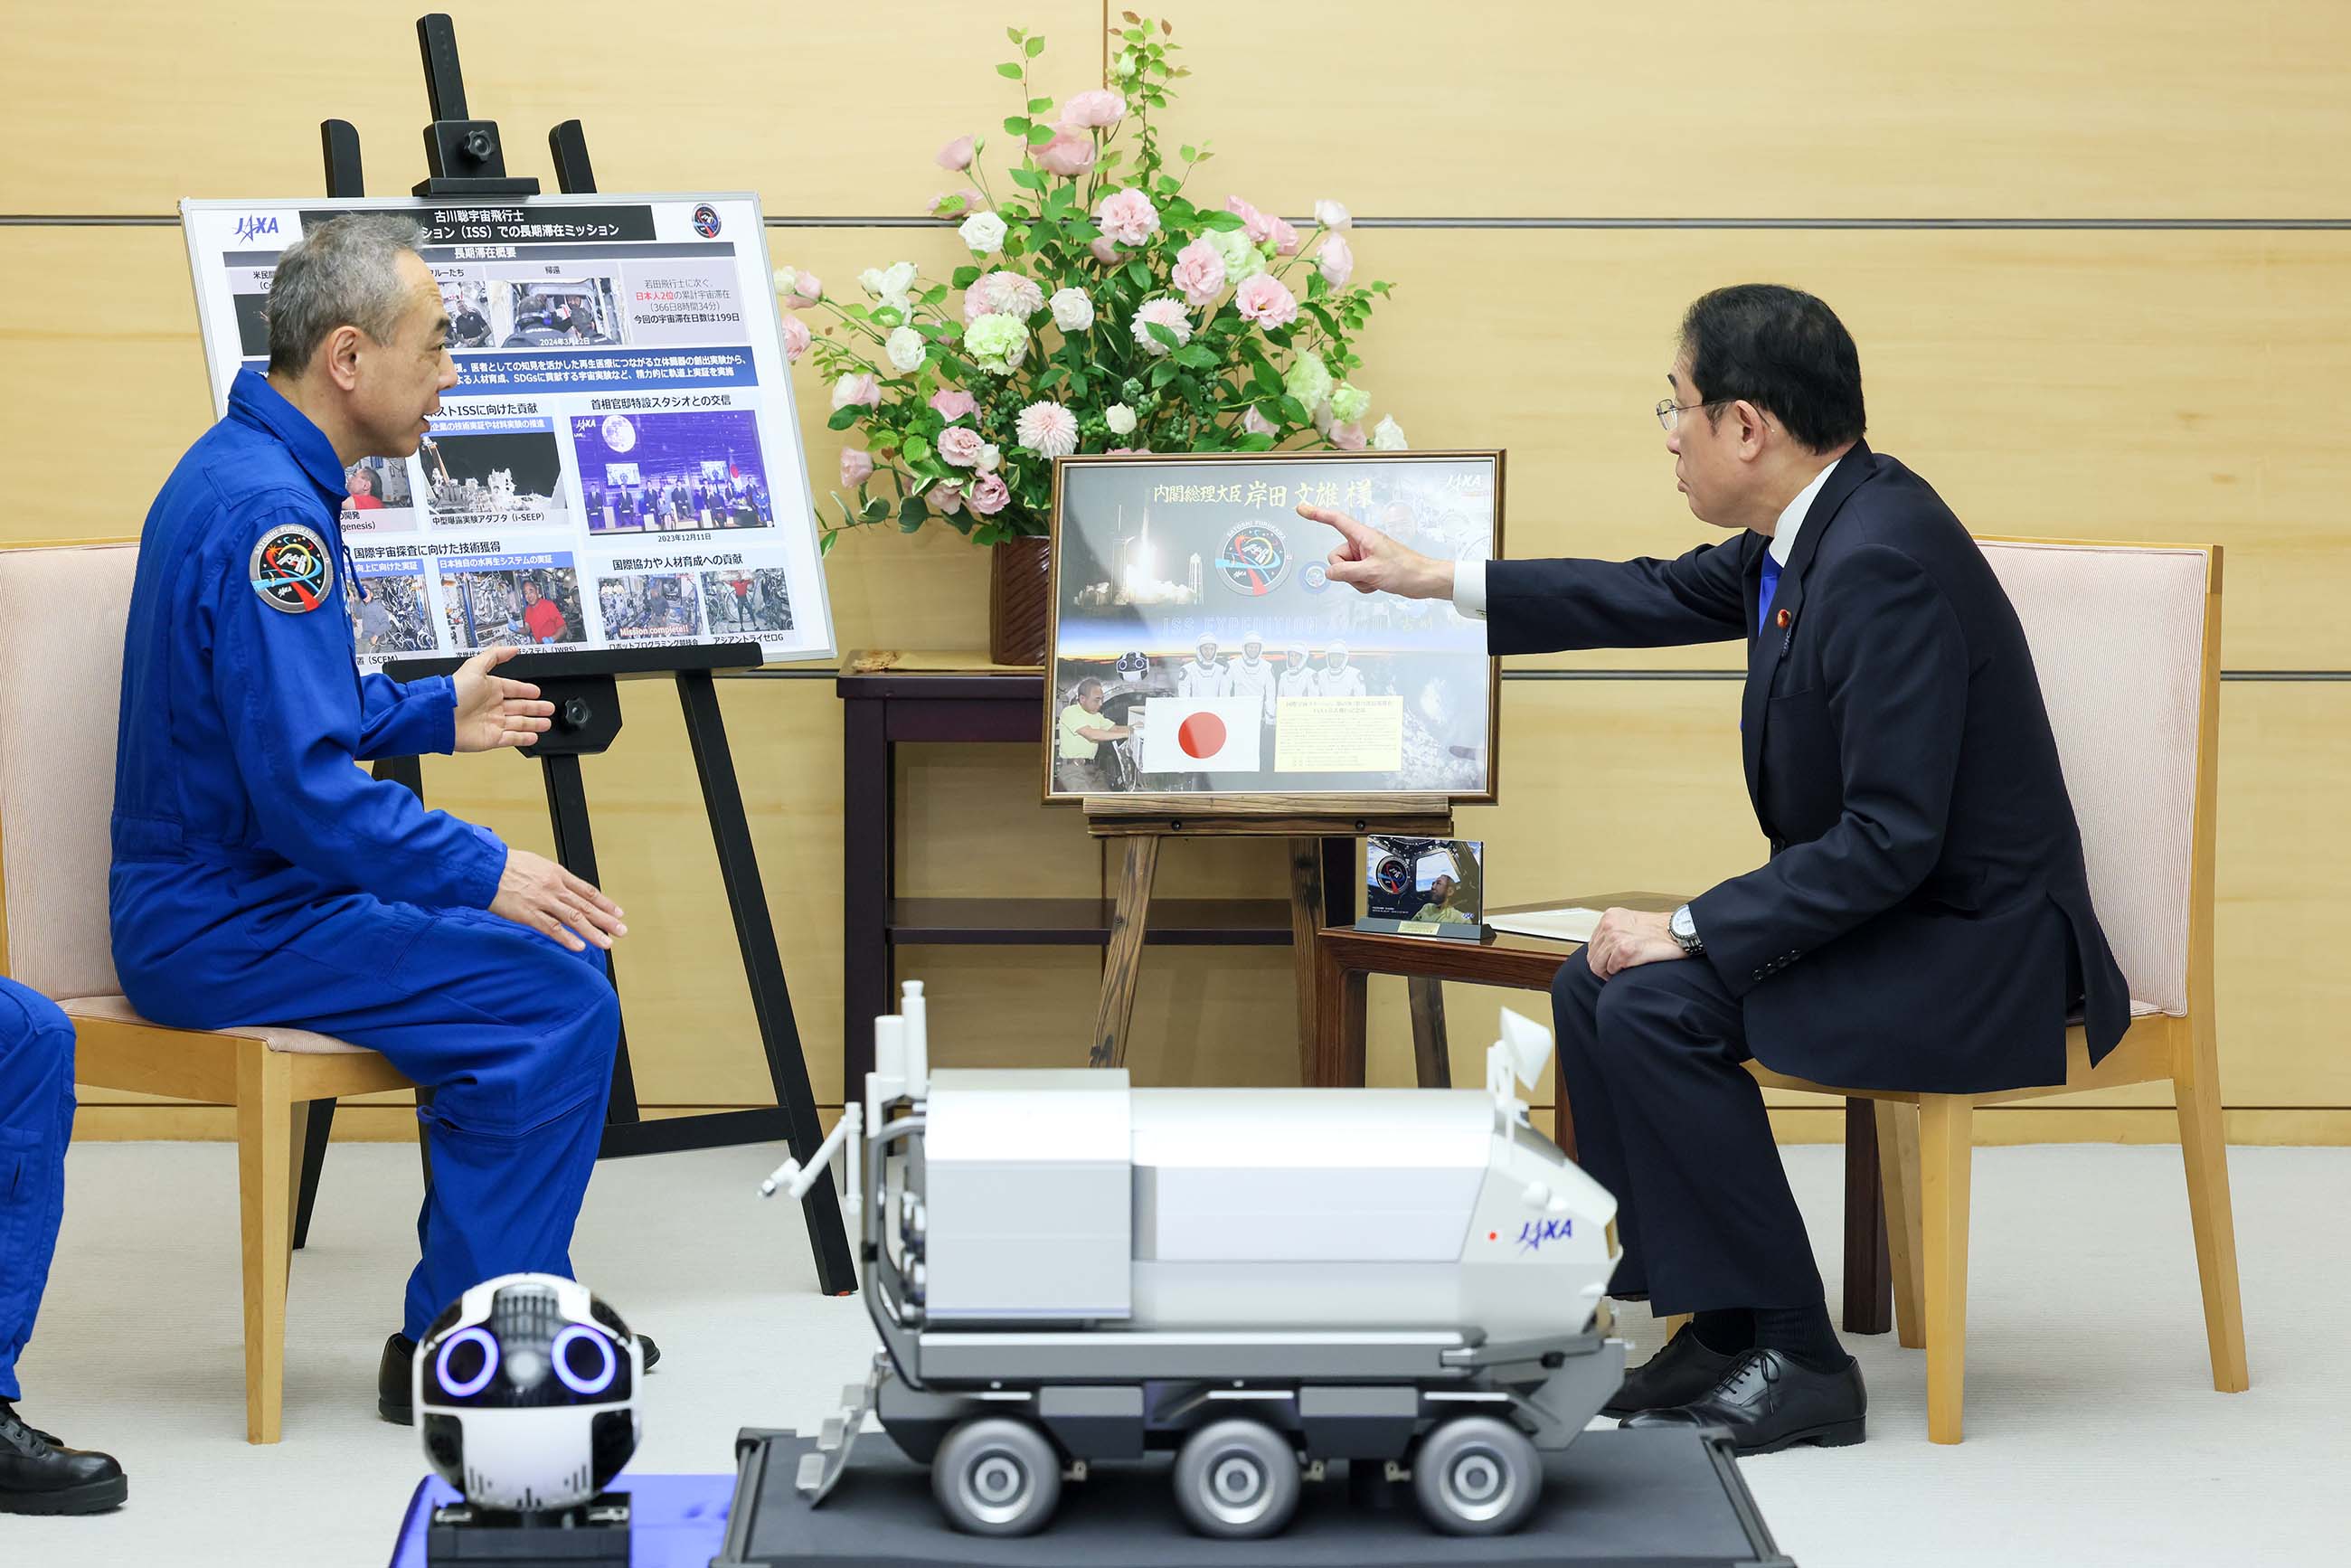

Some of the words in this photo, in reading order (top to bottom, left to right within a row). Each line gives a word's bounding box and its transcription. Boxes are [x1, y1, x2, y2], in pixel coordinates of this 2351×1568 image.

[434, 209, 524, 223] 古川聡宇宙飛行士
[233, 214, 279, 245] JAXA
[454, 246, 517, 260] 長期滞在概要
[545, 266, 561, 275] 帰還
[636, 289, 731, 301] 日本人2位の累計宇宙滞在
[634, 312, 741, 324] 今回の宇宙滞在日数は199日
[591, 394, 732, 410] 首相官邸特設スタジオとの交信
[428, 402, 538, 418] ストISSに向けた貢献
[430, 419, 545, 431] 企業の技術実証や材料実験の推進
[1154, 484, 1242, 505] 内閣総理大臣
[1244, 479, 1287, 510] 岸田
[1295, 481, 1339, 507] 文雄
[1345, 478, 1374, 507] 様
[657, 533, 712, 543] 2023年12月11日
[354, 541, 501, 559] 国際宇宙探査に向けた技術獲得
[345, 561, 418, 573] 向上に向けた実証
[439, 555, 552, 569] 日本独自の水再生システムの実証
[612, 553, 743, 571] 国際協力や人材育成への貢献
[620, 627, 648, 637] Mission
[649, 624, 689, 635] complete!!
[1515, 1217, 1573, 1258] JAXA
